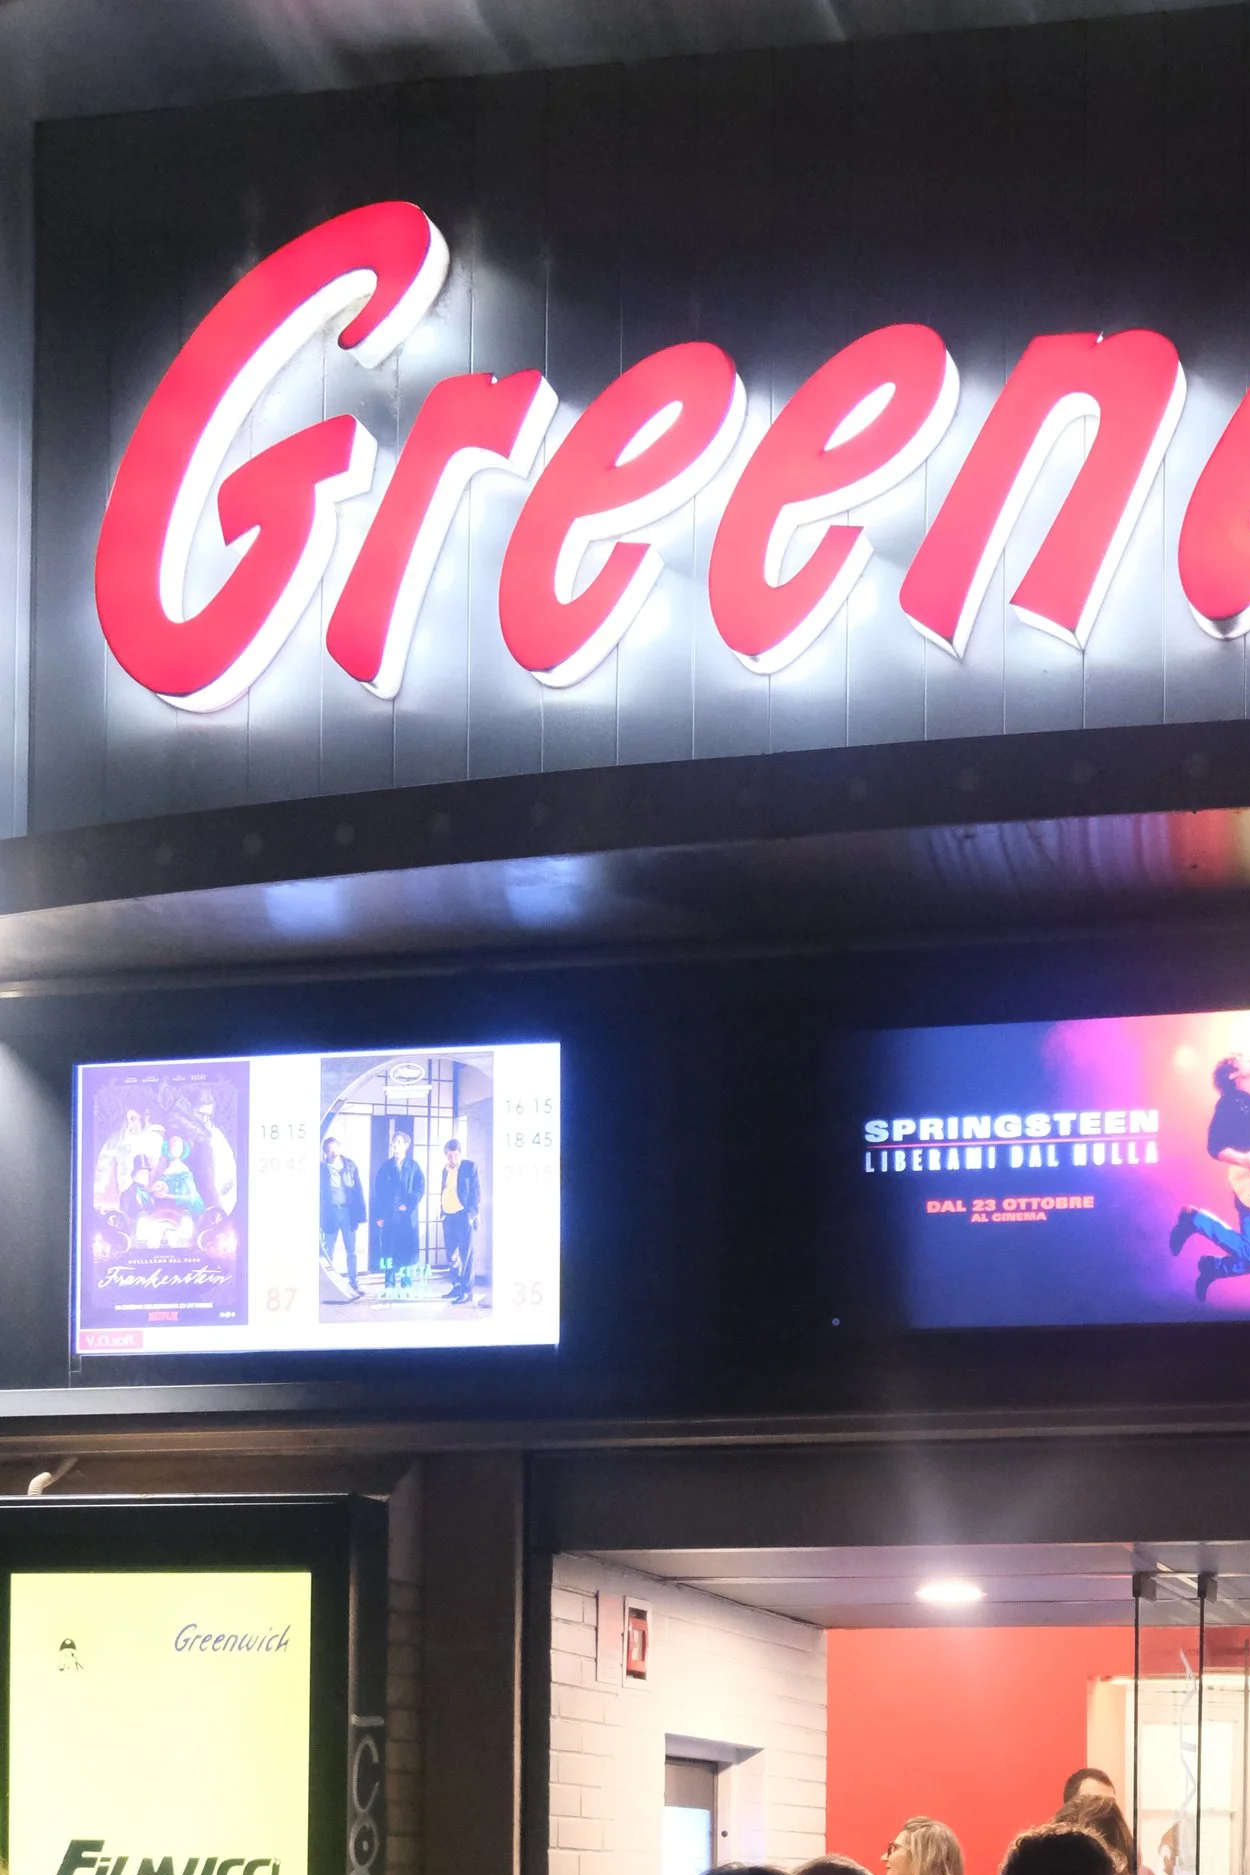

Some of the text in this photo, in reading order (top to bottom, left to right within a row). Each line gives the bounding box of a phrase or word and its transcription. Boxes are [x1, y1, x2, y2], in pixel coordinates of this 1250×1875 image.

[865, 1109, 1160, 1143] SPRINGSTEEN
[865, 1140, 1159, 1173] LIBERAMI DAL NULLA
[926, 1196, 1095, 1214] DAL 23 OTTOBRE
[970, 1211, 1048, 1223] AL CINEMA
[97, 1265, 232, 1289] Frankenstein
[265, 1286, 299, 1313] 87
[511, 1281, 545, 1307] 35
[174, 1622, 291, 1653] Greenwich
